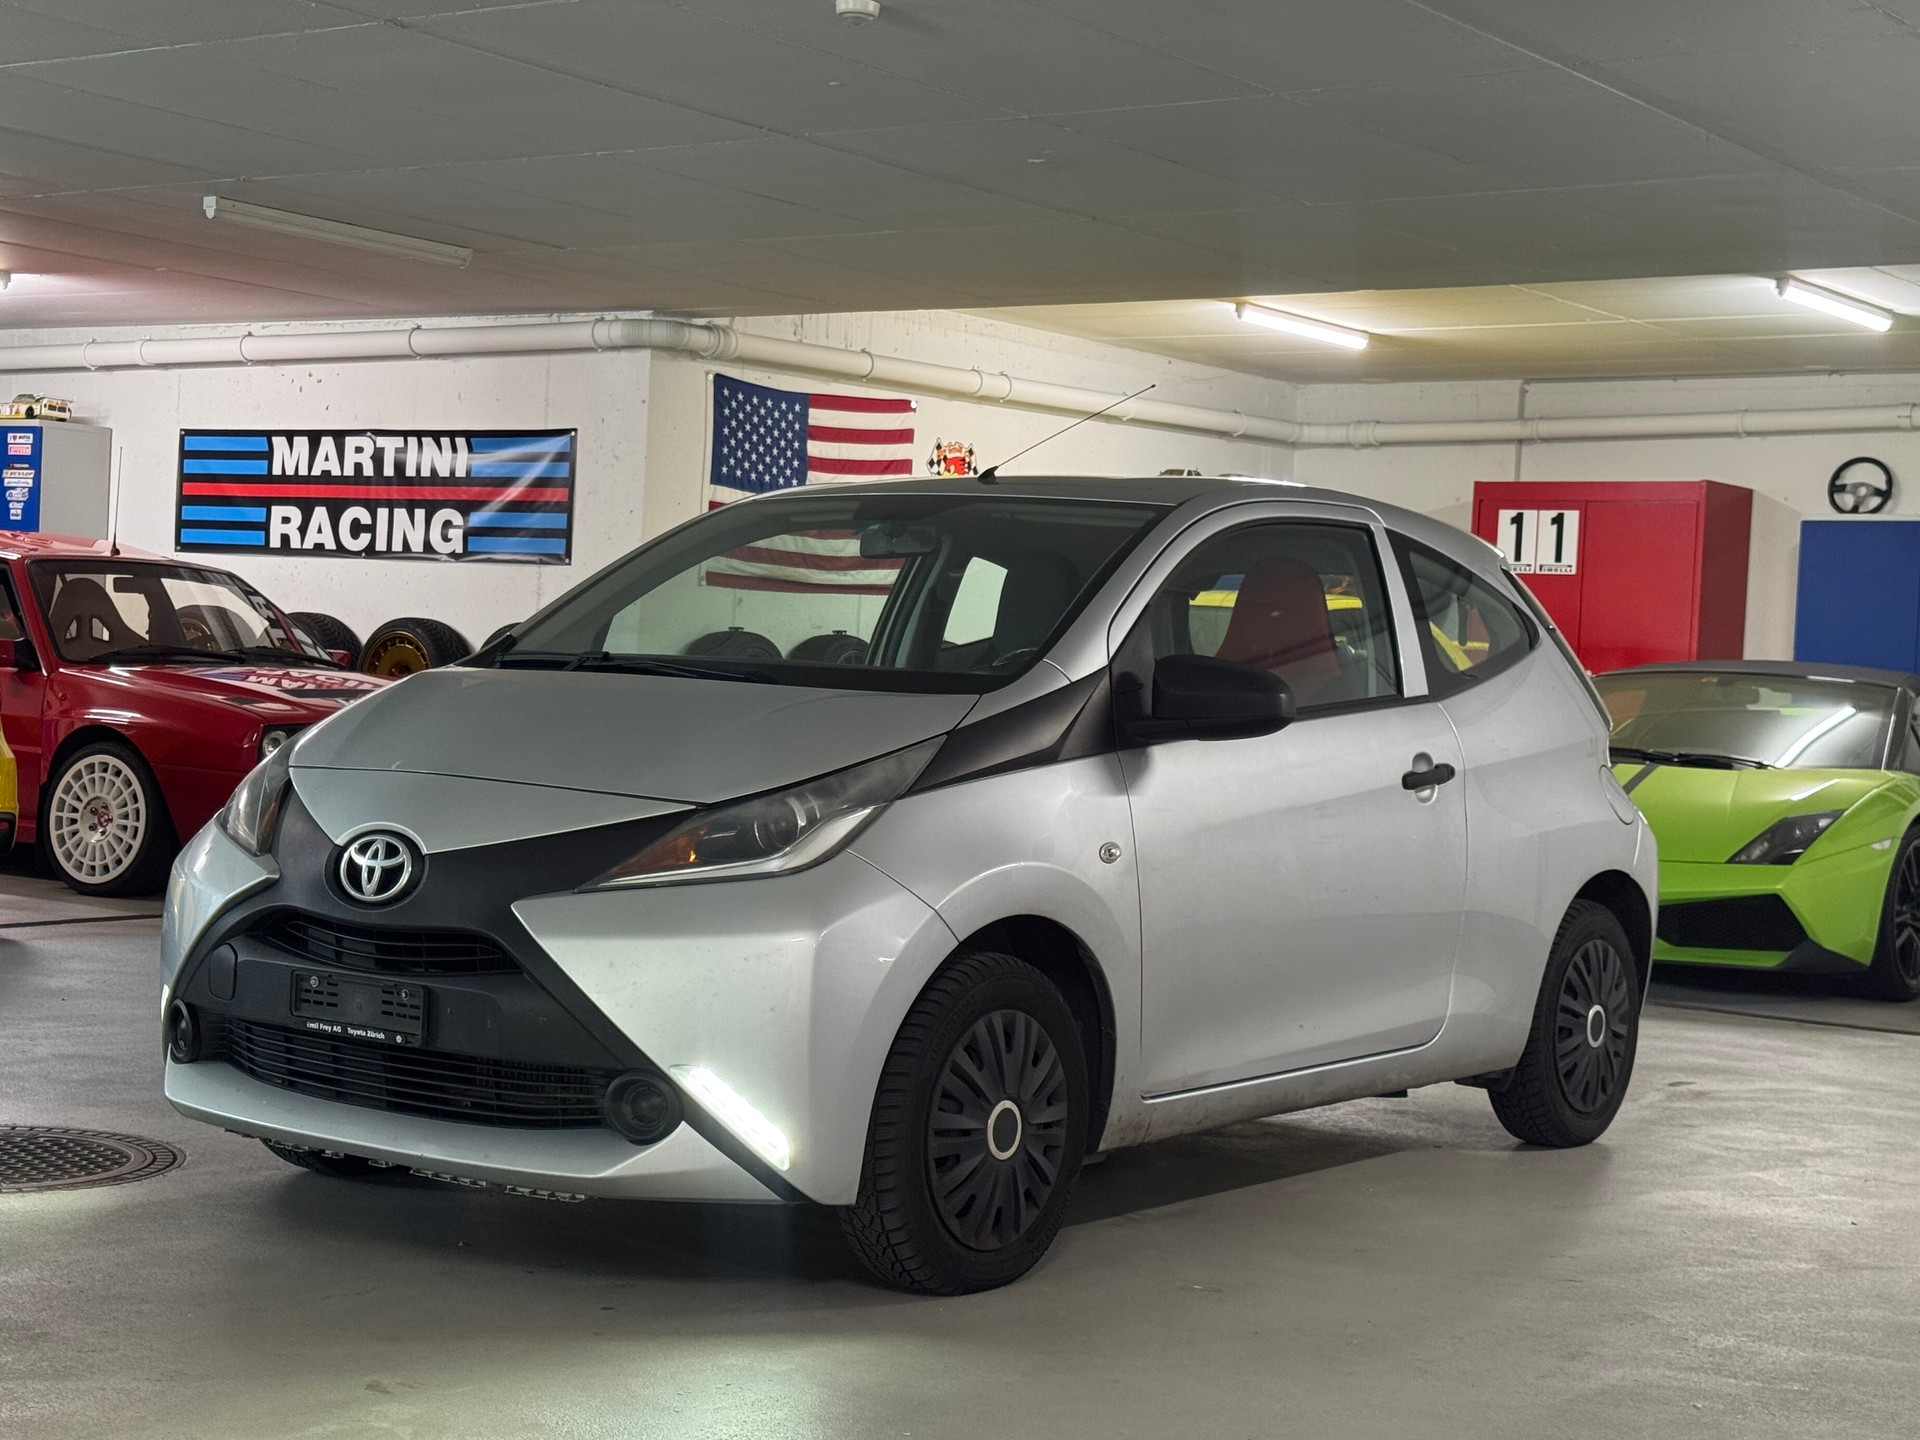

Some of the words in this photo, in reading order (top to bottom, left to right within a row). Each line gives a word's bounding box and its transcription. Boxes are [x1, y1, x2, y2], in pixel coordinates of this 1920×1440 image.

[272, 436, 471, 478] MARTINI
[269, 505, 465, 554] RACING
[320, 1023, 332, 1032] Frey
[347, 1028, 366, 1036] Toyota
[367, 1030, 385, 1039] Zürich
